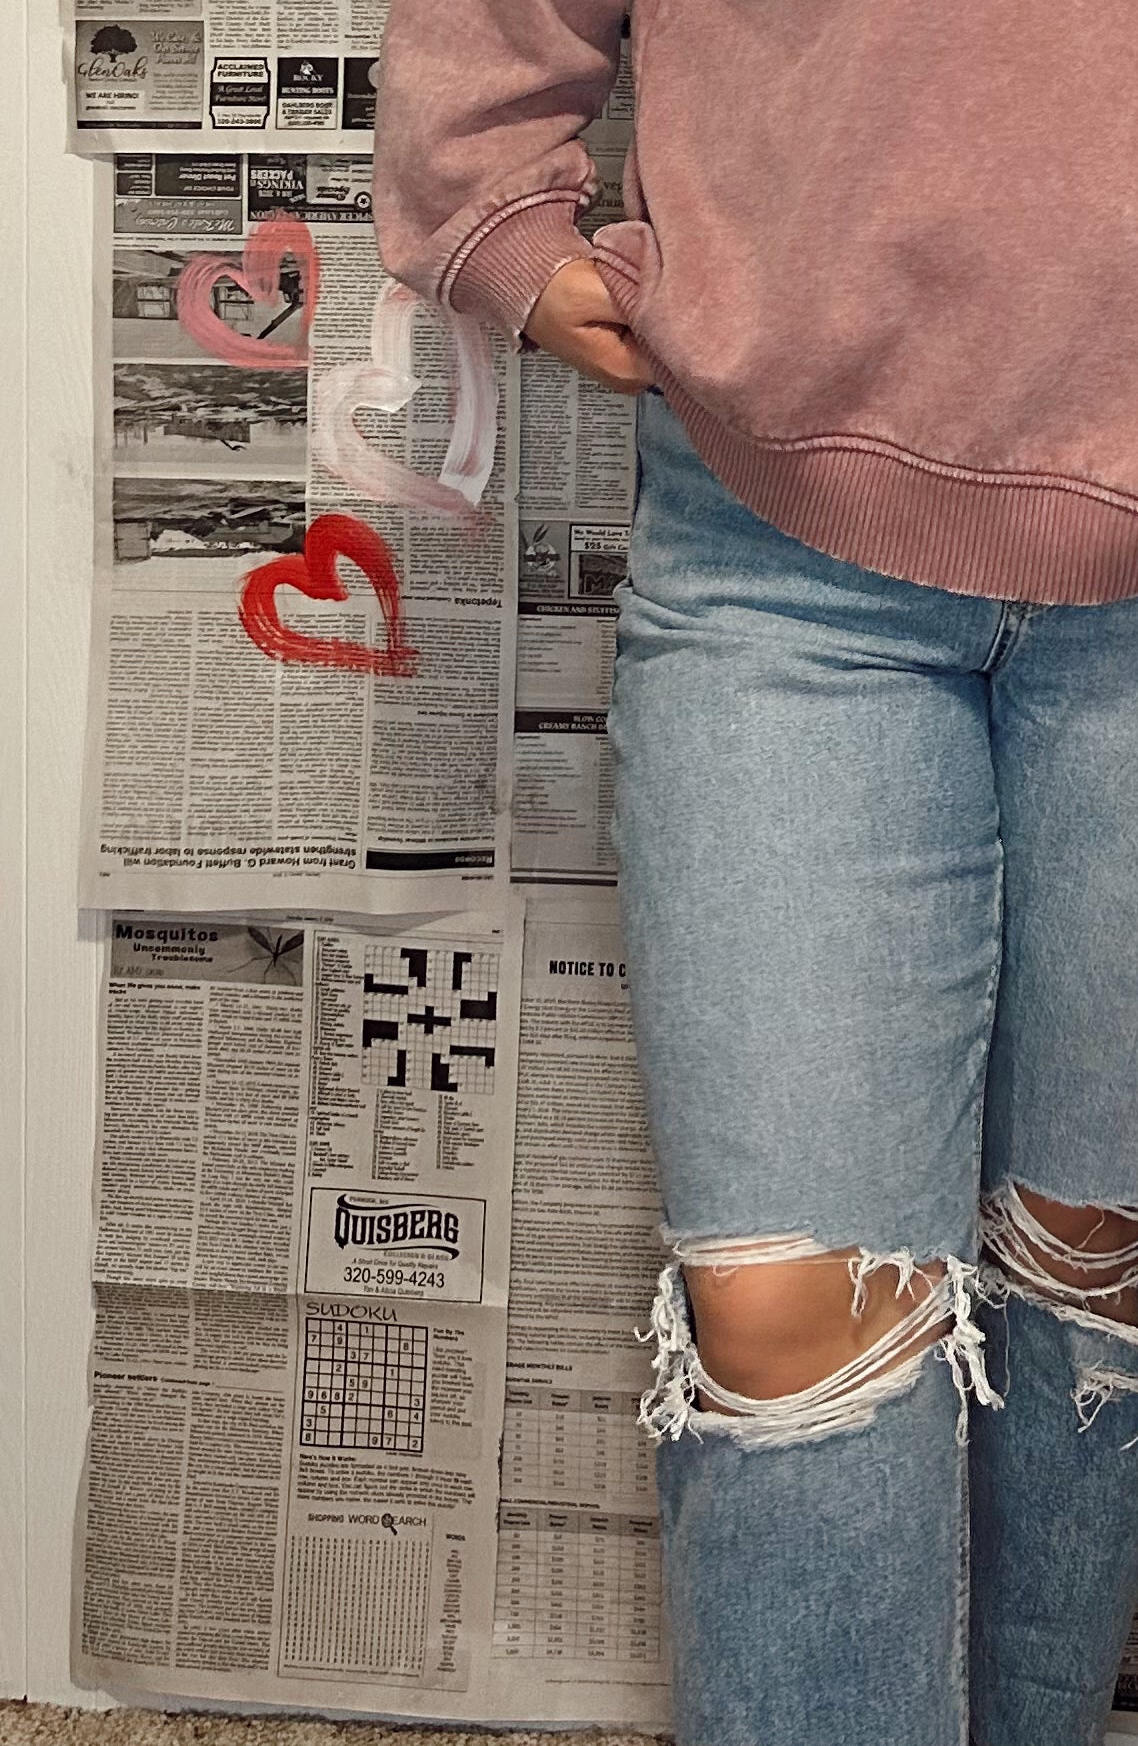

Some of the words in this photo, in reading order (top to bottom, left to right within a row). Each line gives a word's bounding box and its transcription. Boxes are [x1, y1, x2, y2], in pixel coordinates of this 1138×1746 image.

[114, 924, 218, 943] Mosquitos
[548, 959, 594, 976] NOTICE
[597, 960, 614, 977] TO
[334, 1207, 458, 1248] QUISBERG
[343, 1266, 444, 1288] 320-599-4243
[304, 1301, 397, 1321] SUDOKU
